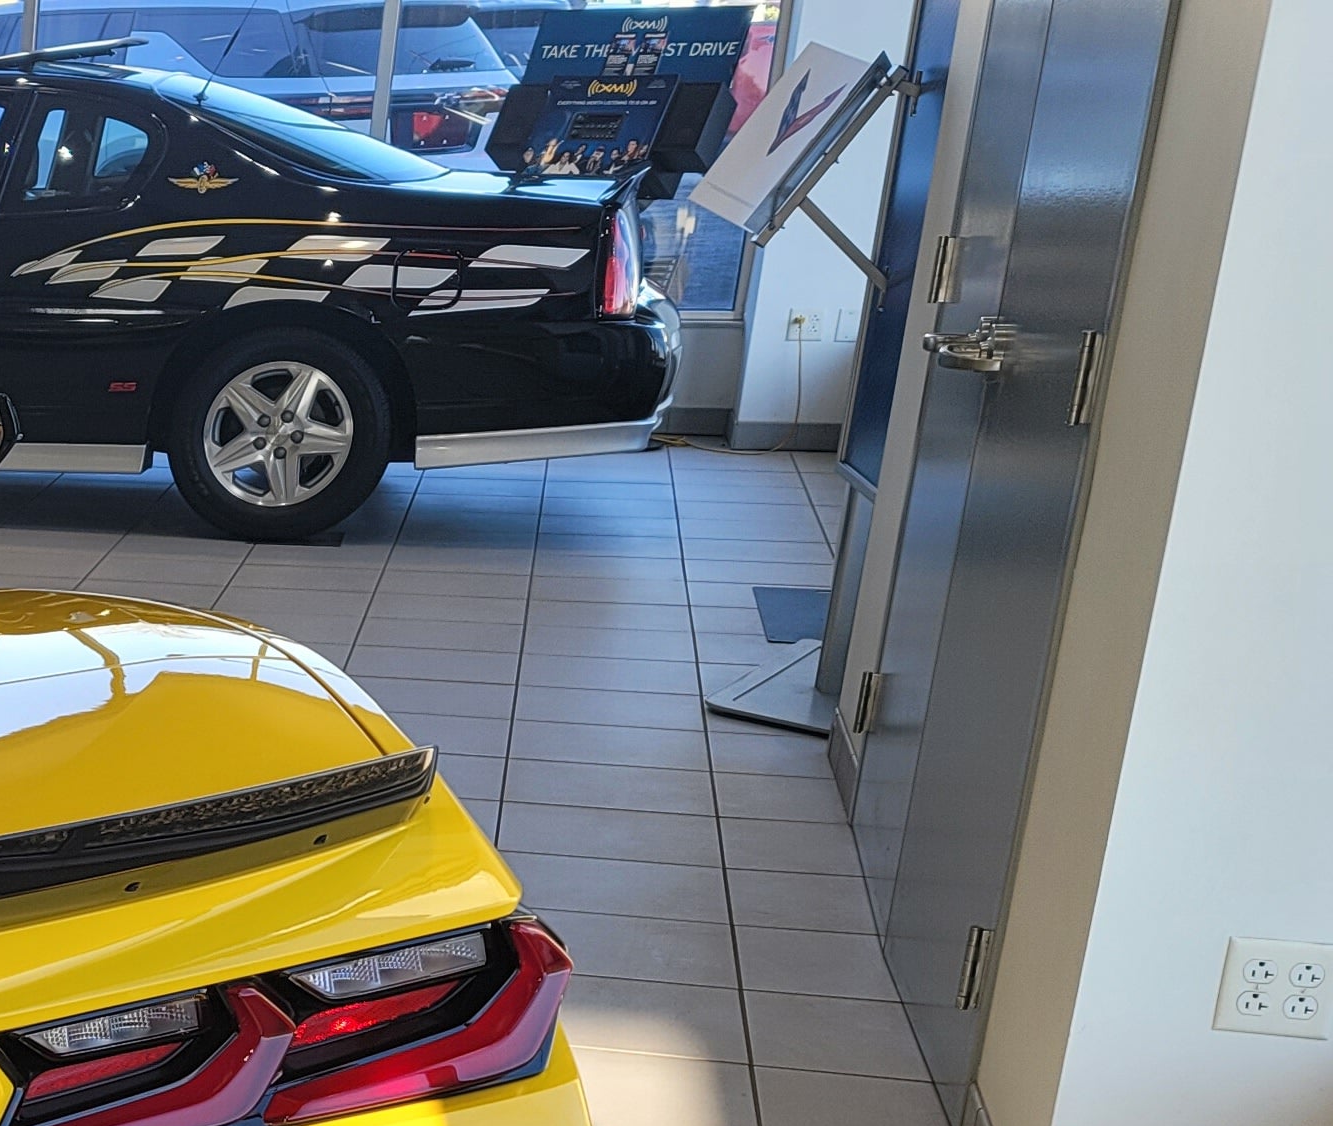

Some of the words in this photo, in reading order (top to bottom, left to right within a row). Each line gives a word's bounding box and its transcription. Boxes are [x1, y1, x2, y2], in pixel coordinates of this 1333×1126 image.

[540, 44, 579, 59] TAKE
[689, 41, 740, 57] DRIVE
[108, 382, 137, 392] SS
